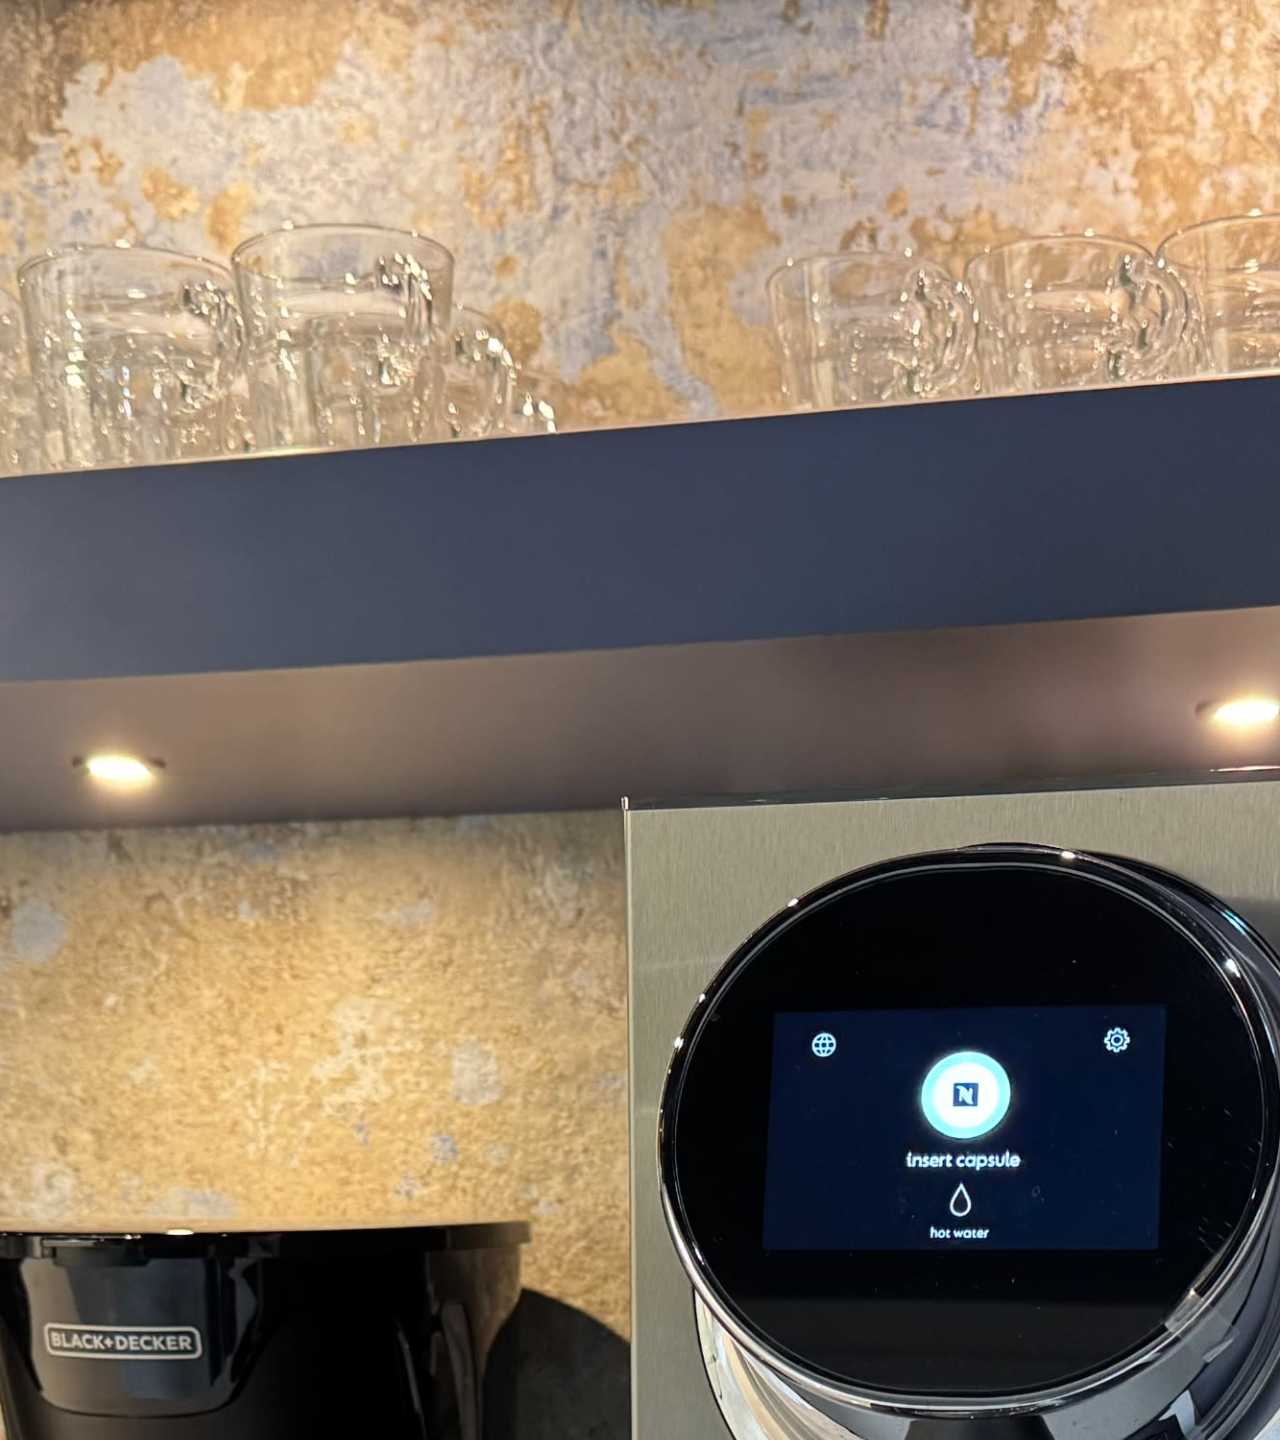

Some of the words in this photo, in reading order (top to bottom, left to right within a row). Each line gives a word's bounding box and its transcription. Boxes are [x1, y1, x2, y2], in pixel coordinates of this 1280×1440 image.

[906, 1151, 953, 1168] insert
[956, 1151, 1021, 1171] capsule
[929, 1226, 951, 1239] hot
[953, 1228, 990, 1239] water
[50, 1330, 192, 1351] BLACK+DECKER
